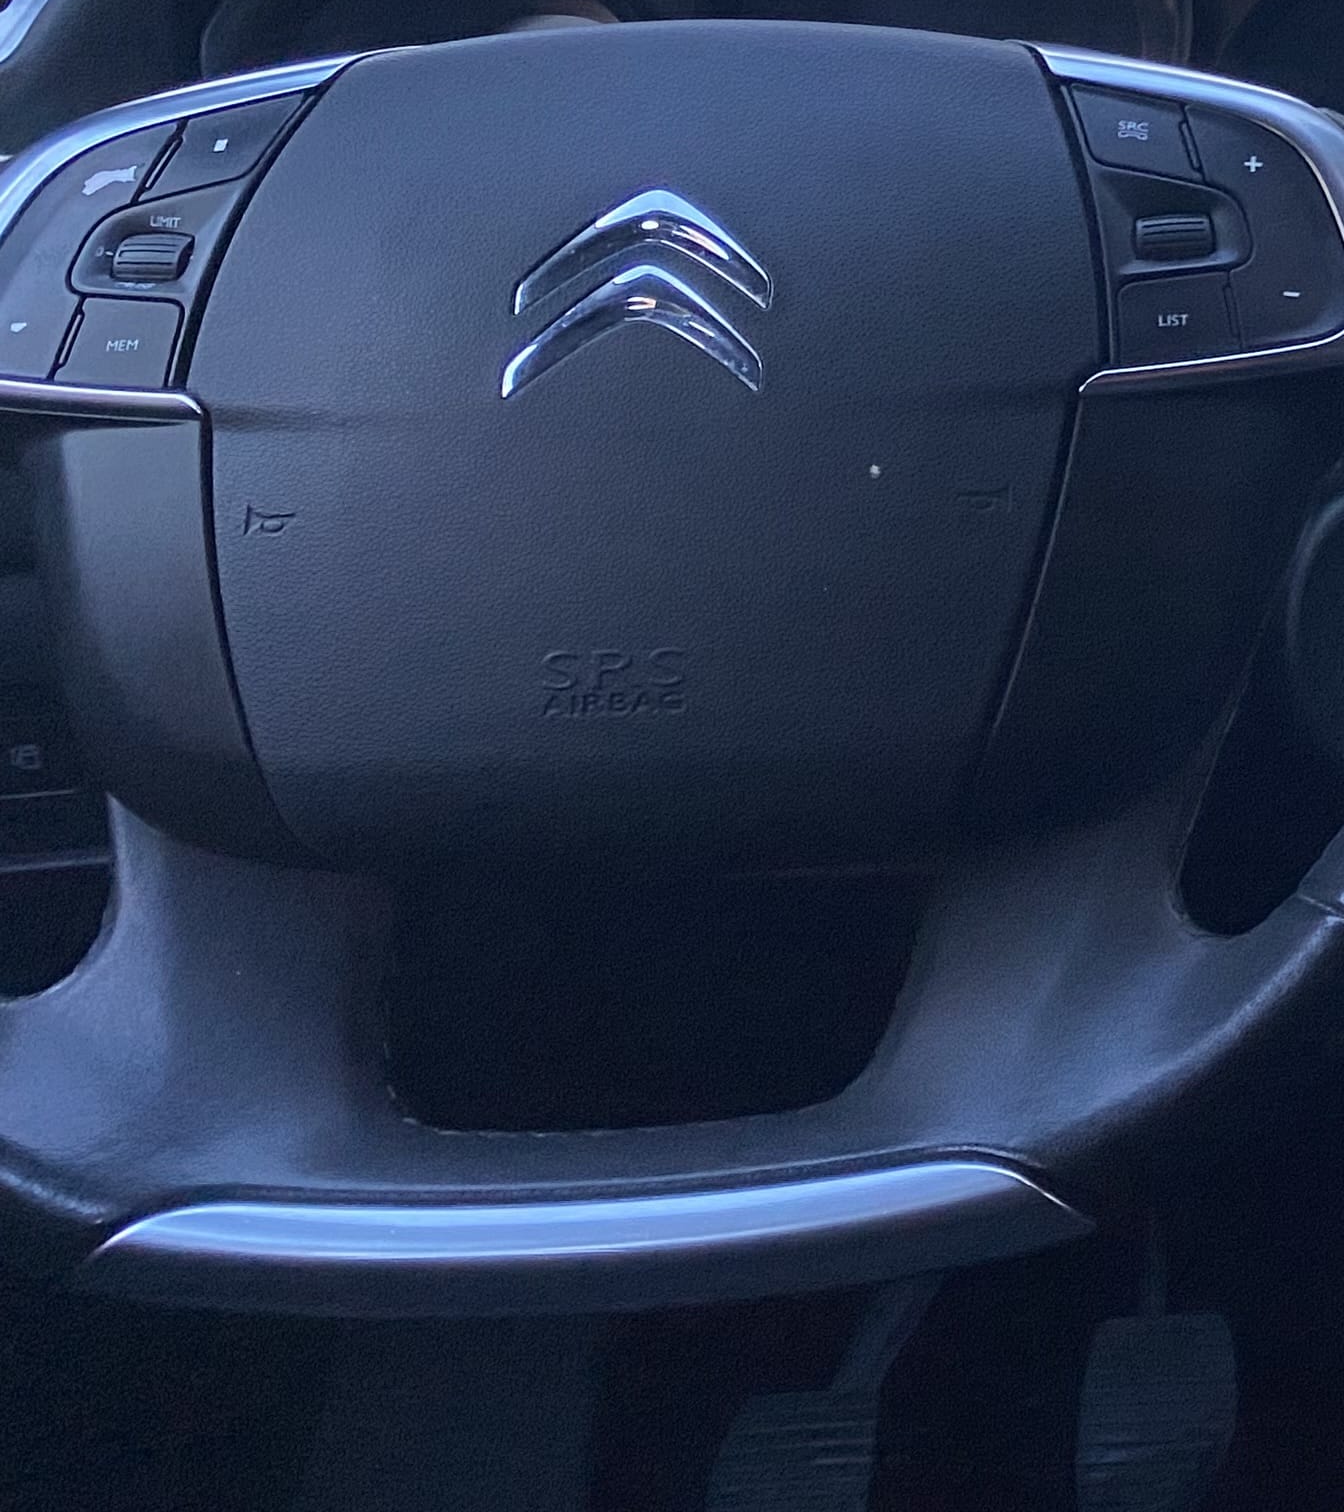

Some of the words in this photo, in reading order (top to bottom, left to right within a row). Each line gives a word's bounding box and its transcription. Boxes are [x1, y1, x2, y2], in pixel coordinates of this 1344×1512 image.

[1117, 119, 1149, 132] SRC
[149, 214, 182, 229] LIMIT
[1157, 313, 1189, 327] LIST
[105, 338, 139, 353] MEM
